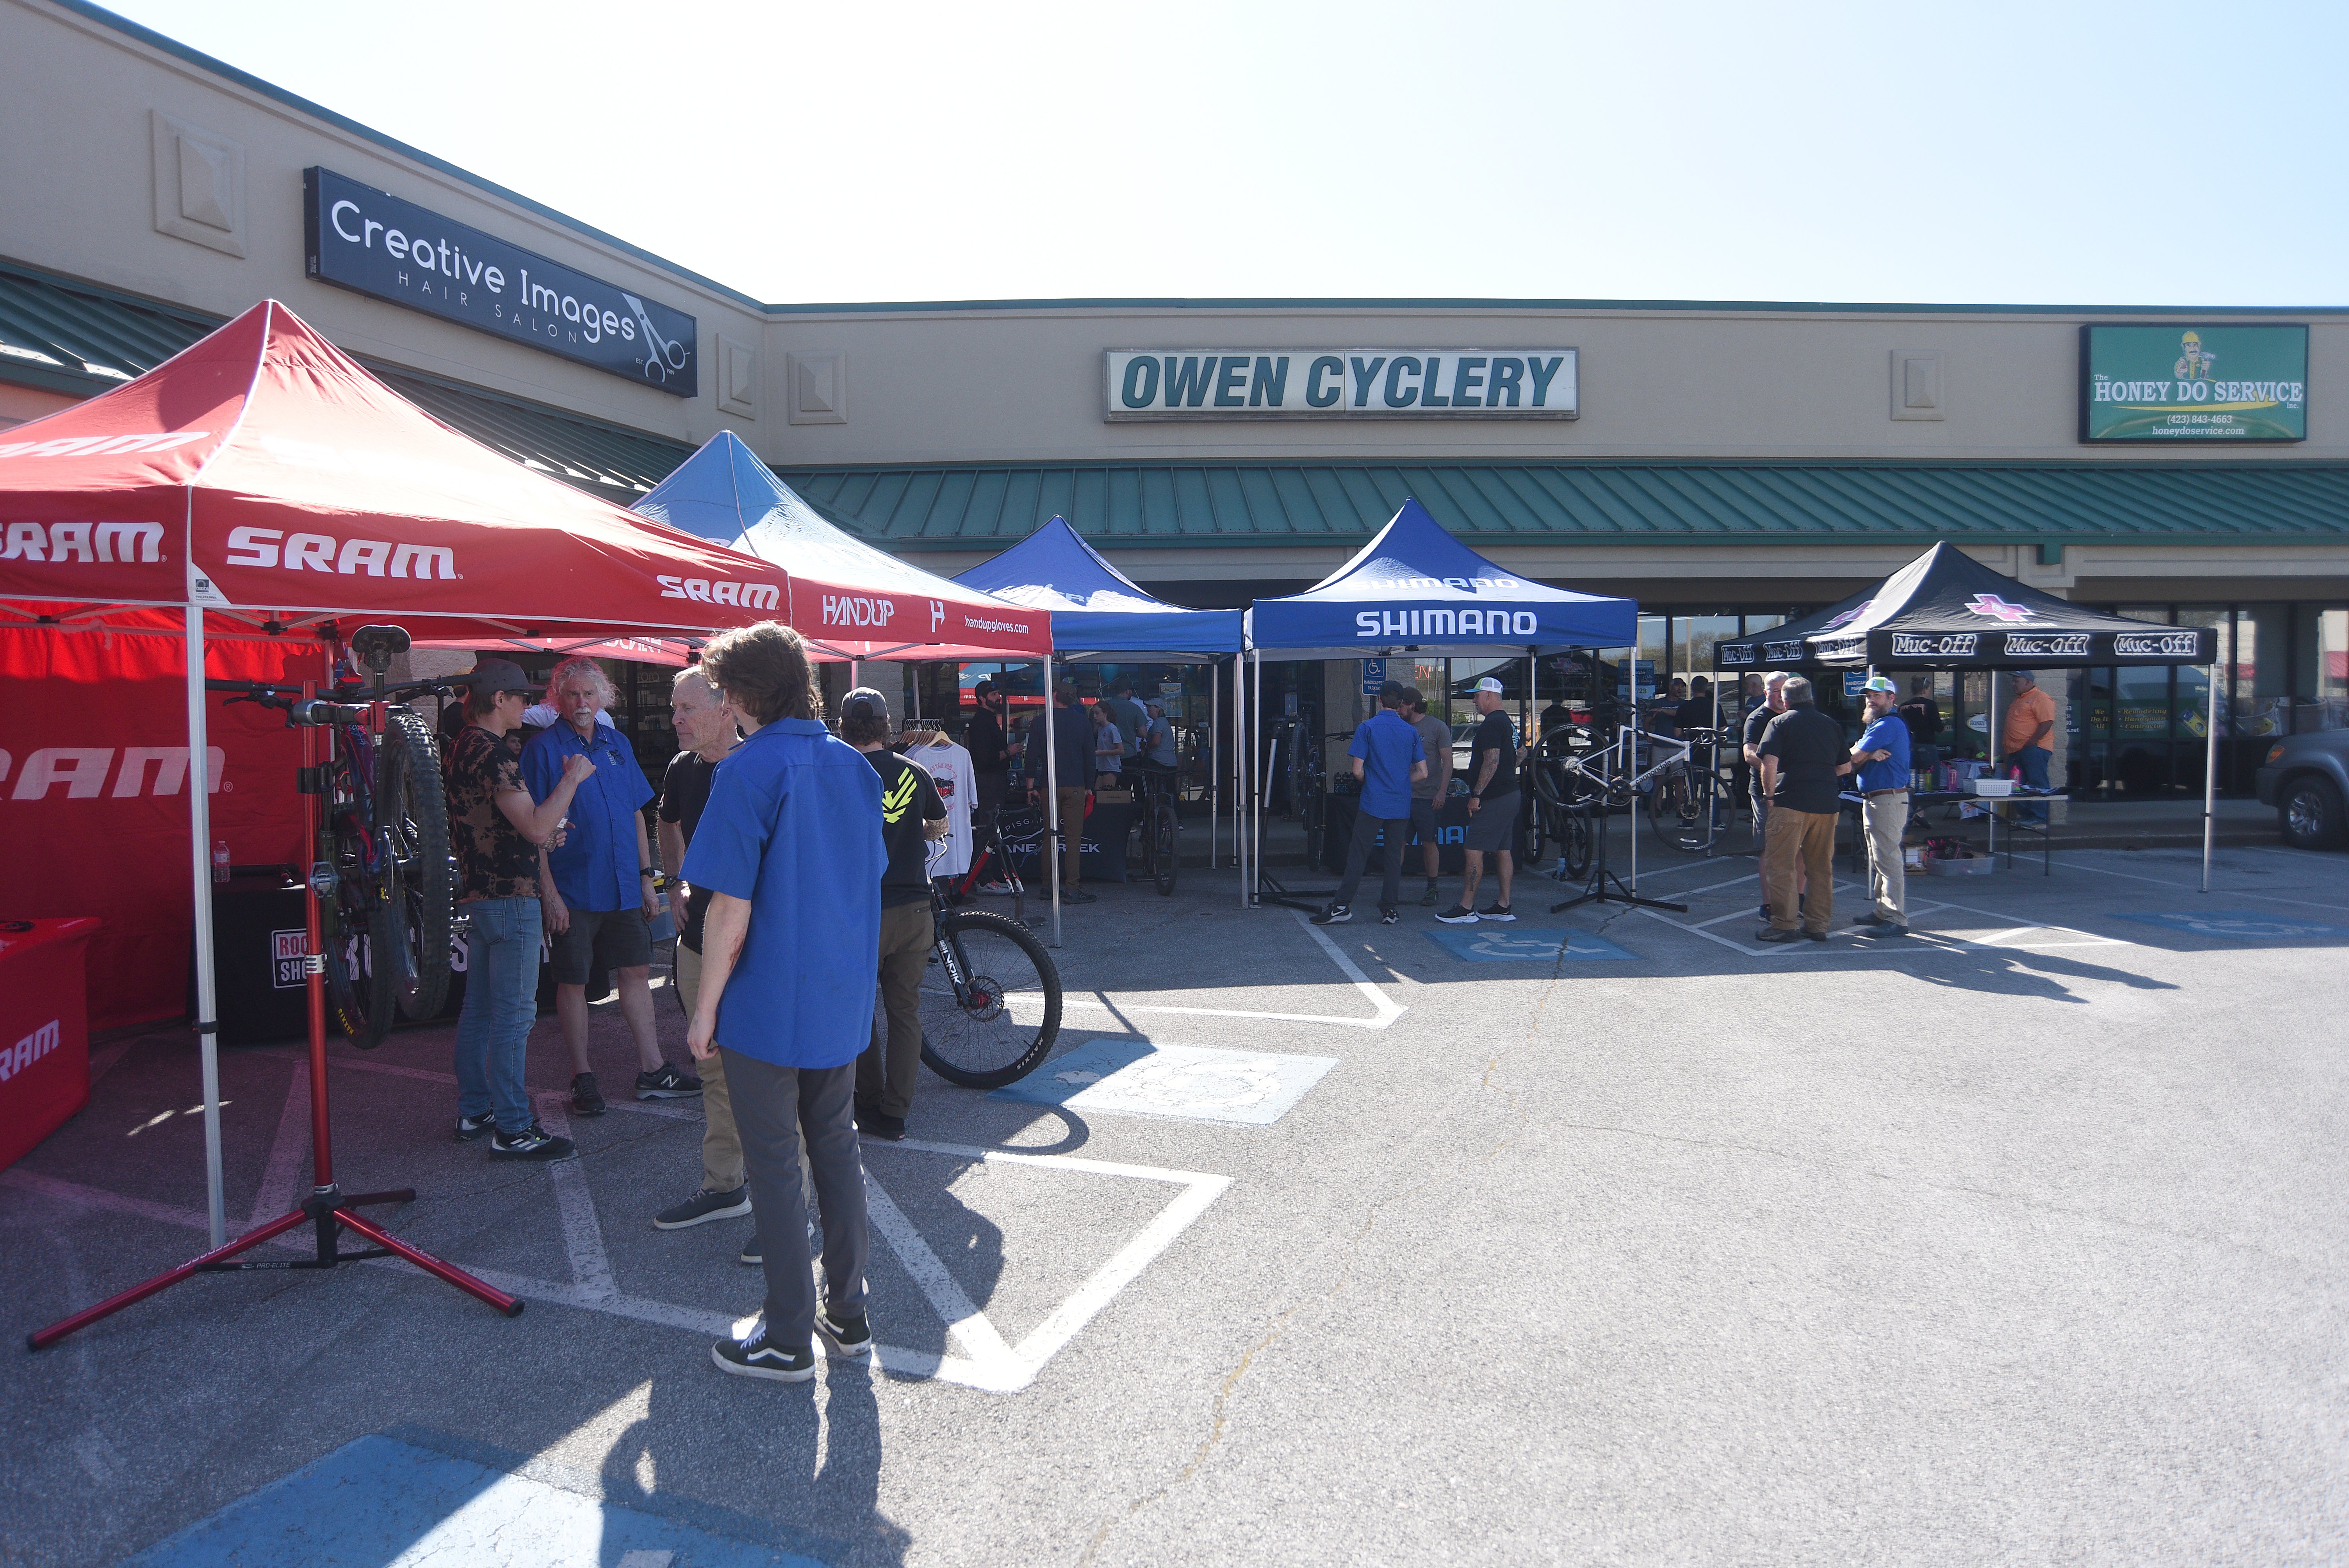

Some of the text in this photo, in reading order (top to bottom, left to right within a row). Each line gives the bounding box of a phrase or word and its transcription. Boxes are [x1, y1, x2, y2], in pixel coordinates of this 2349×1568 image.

[331, 200, 635, 344] Creative Images
[398, 271, 577, 344] HAIR SALON
[1121, 356, 1564, 408] OWEN CYCLERY
[2094, 381, 2303, 402] HONEY DO SERVICE
[2152, 426, 2244, 435] honeydoservice.com
[2167, 415, 2232, 424] (423) 843-4663
[227, 526, 456, 580] SRAM
[656, 575, 780, 610] SRAM
[823, 595, 894, 626] HANDUP
[964, 615, 1029, 634] handupgloves.com
[1356, 609, 1537, 636] SHIMANO
[1723, 646, 1753, 662] Muc-Off
[1767, 642, 1801, 659] Muc-Off
[1816, 637, 1855, 656] Muc-Off
[1896, 636, 1973, 653] Muc-Off
[2009, 637, 2084, 653] Muc-Off
[2119, 635, 2195, 653] Muc-Off
[1635, 760, 1671, 784] cannondale
[338, 1008, 355, 1035] MAXXIS
[1016, 1037, 1044, 1070] MAXXIS
